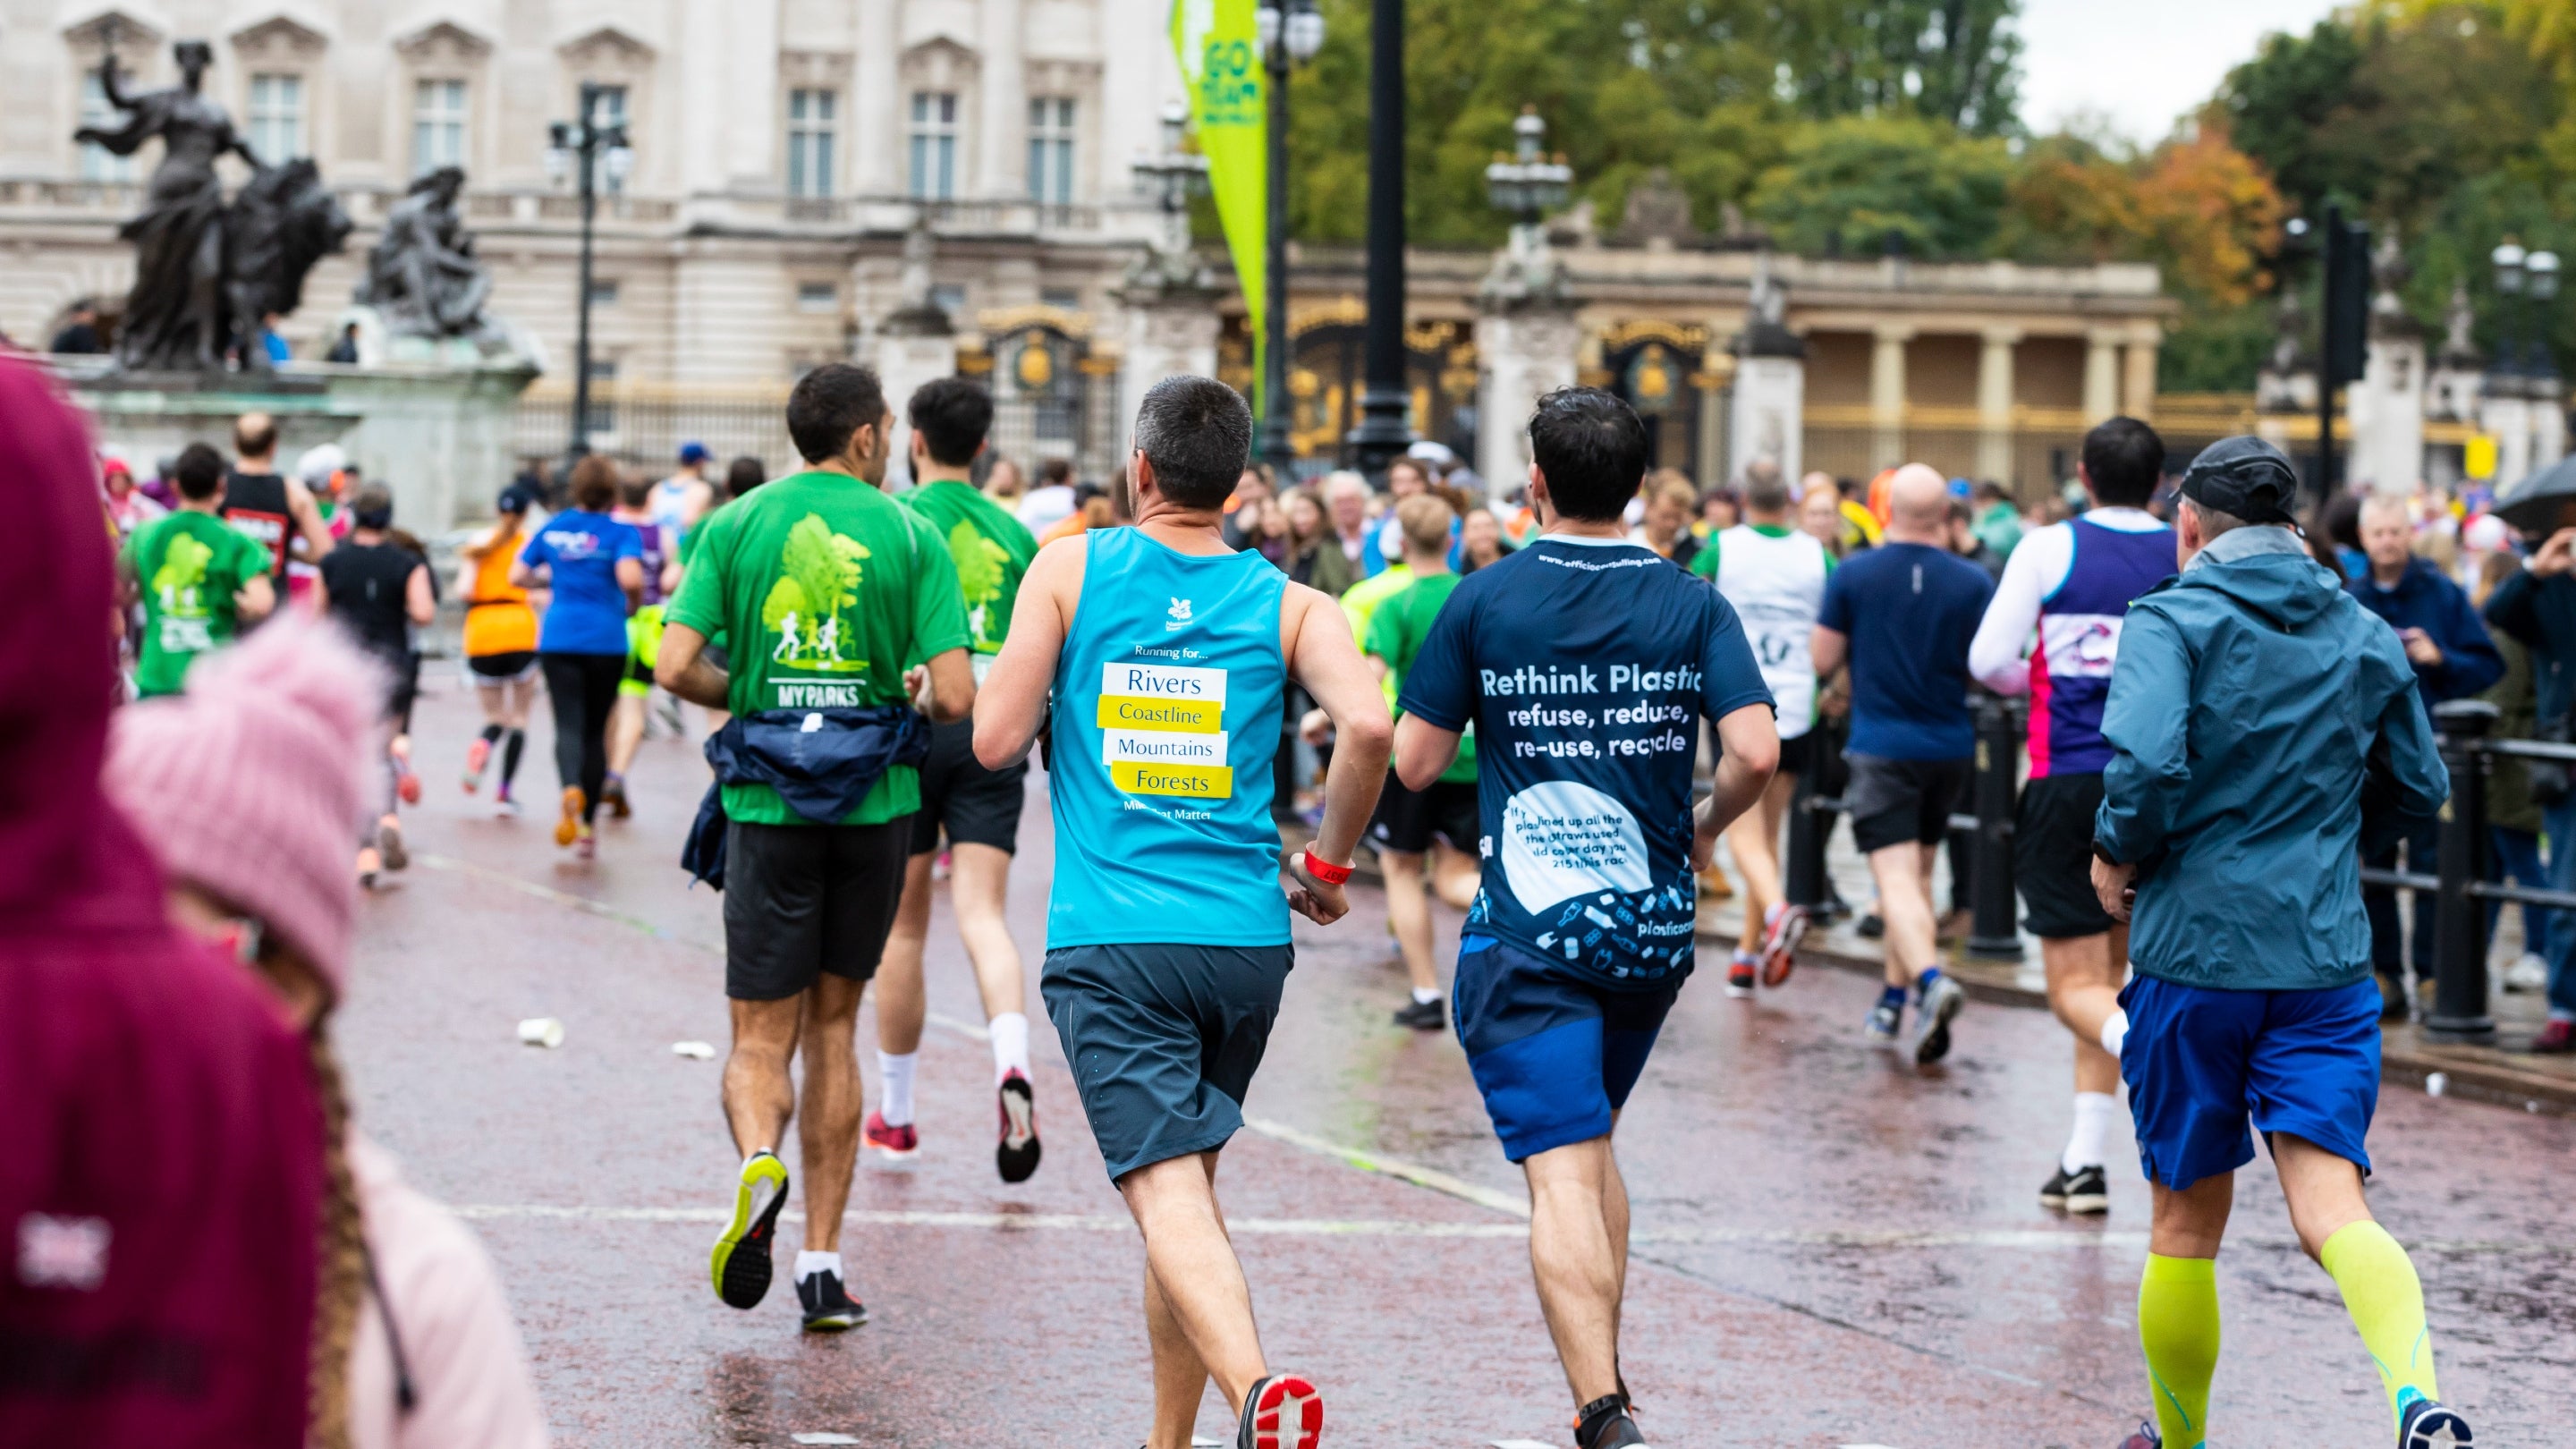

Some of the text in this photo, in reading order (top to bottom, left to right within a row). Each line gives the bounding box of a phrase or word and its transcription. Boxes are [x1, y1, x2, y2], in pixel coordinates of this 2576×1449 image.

[1135, 645, 1208, 660] Running for...
[1128, 669, 1201, 695] Rivers
[1480, 665, 1599, 696] Rethink
[1119, 703, 1202, 724] Coastline
[1507, 702, 1595, 729] refuse,
[1118, 739, 1213, 757] Mountains
[1514, 728, 1686, 760] re-use, recycle
[1137, 770, 1209, 792] Forests
[1174, 809, 1211, 820] Matter
[1568, 818, 1582, 828] up
[1586, 815, 1600, 826] all
[1603, 814, 1623, 825] the
[1526, 834, 1545, 844] the
[1583, 843, 1606, 854] day
[1553, 859, 1572, 869] 215
